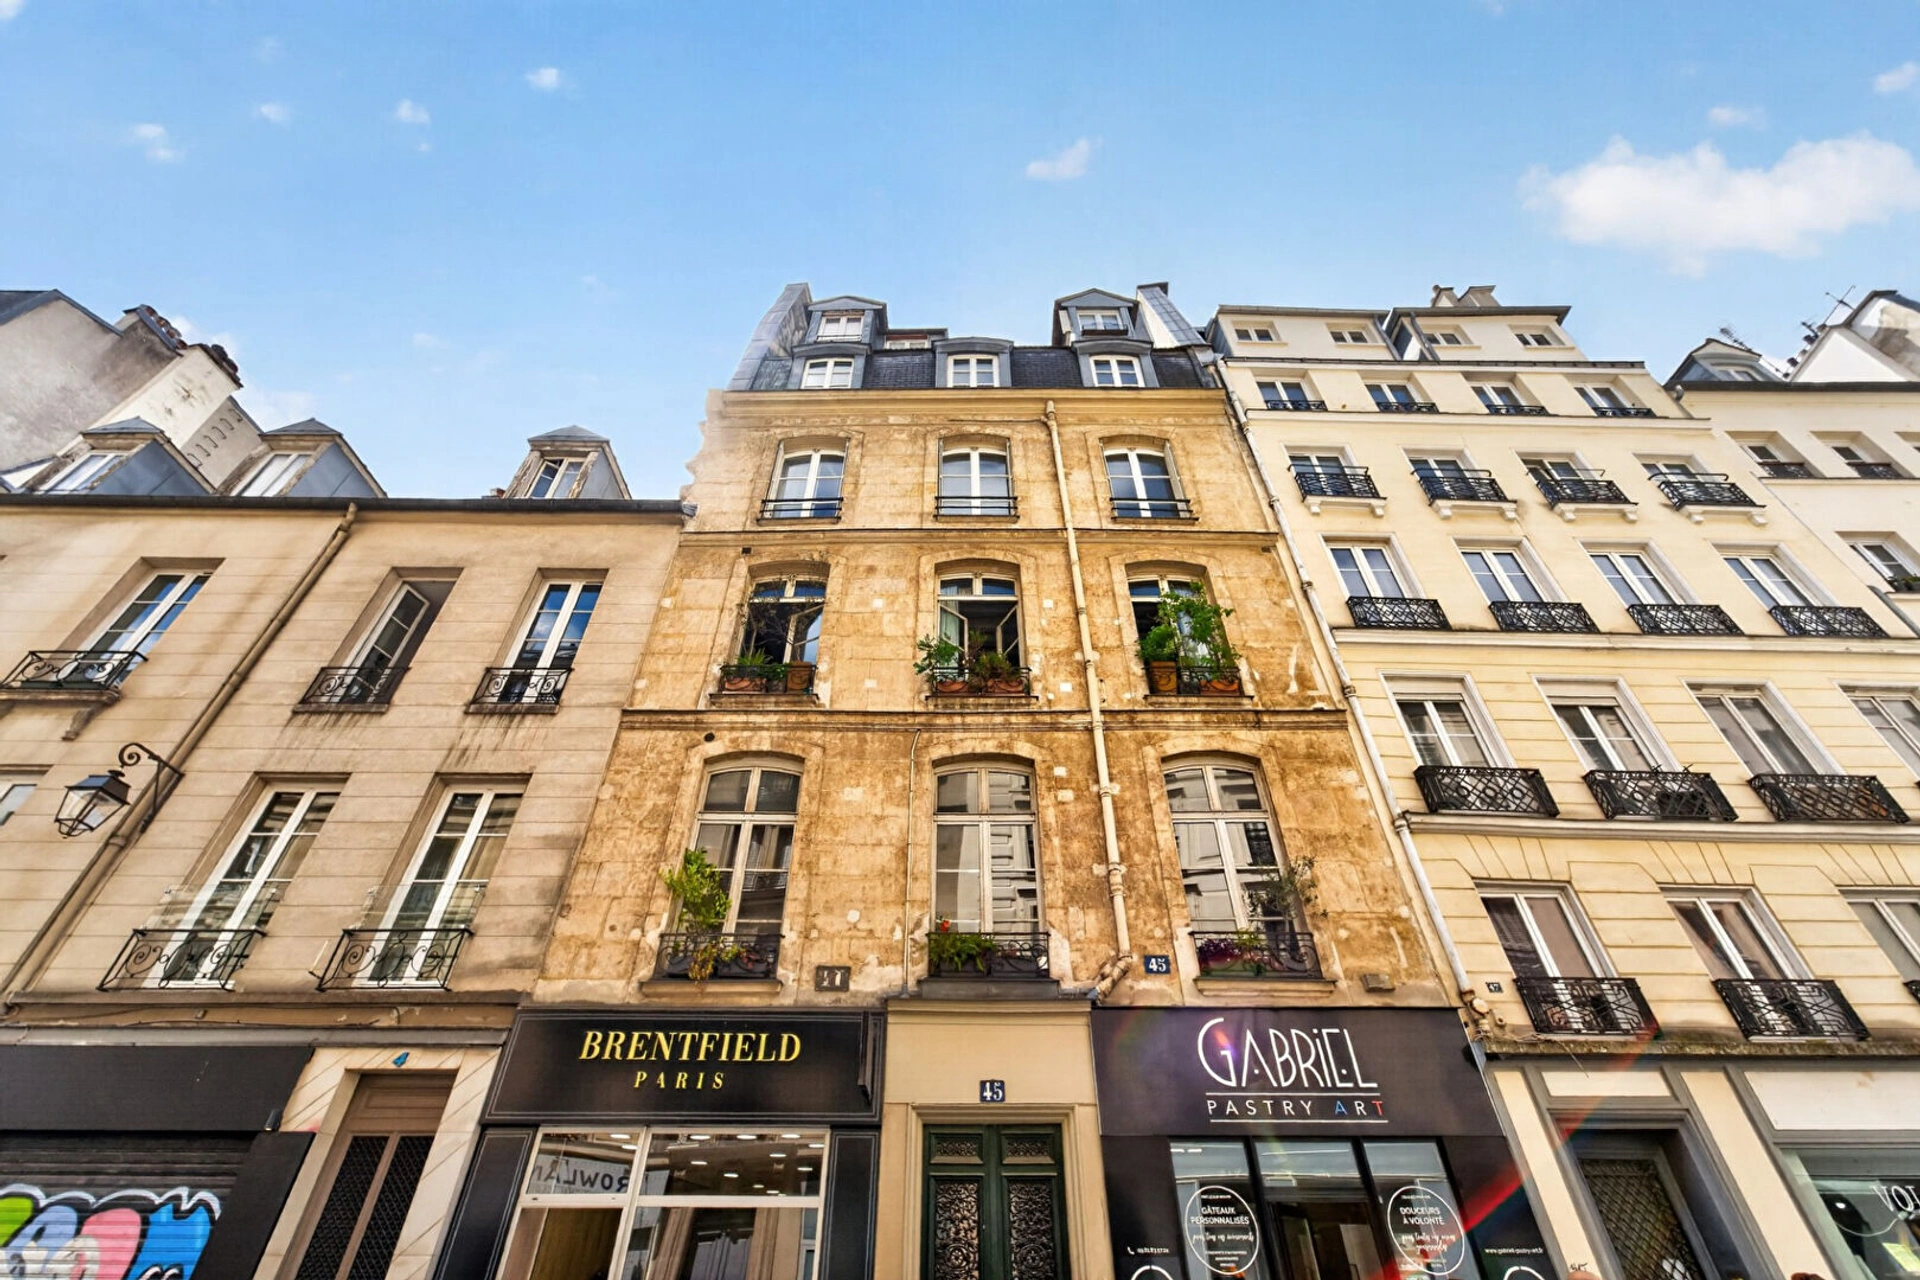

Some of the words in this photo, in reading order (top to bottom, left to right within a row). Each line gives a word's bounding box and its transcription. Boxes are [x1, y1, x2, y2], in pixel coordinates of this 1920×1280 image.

[1148, 957, 1167, 972] 45
[578, 1030, 801, 1062] BRENTFIELD
[633, 1071, 725, 1090] PARIS
[982, 1081, 1003, 1101] 45
[1206, 1099, 1312, 1116] PASTRY
[1334, 1100, 1384, 1116] ART
